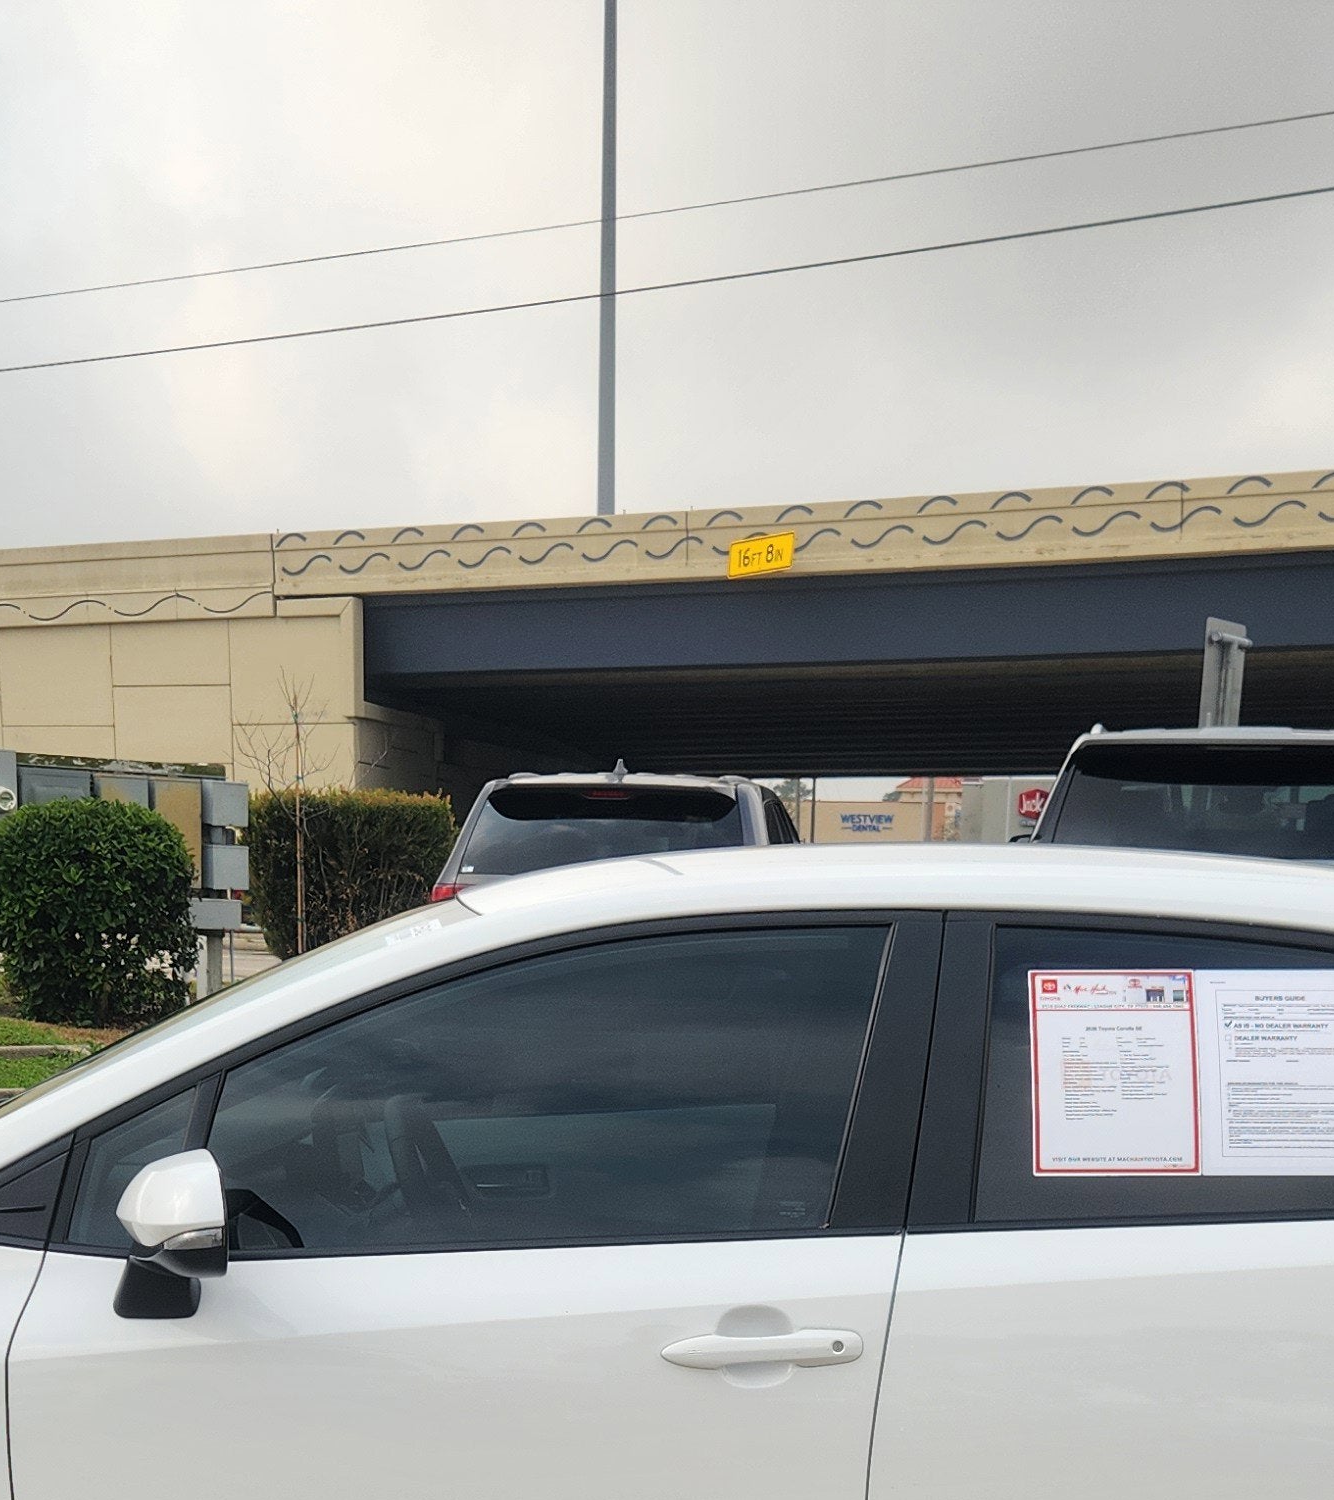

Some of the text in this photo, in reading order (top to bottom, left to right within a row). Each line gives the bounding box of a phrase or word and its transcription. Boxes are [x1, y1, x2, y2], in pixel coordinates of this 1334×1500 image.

[1019, 791, 1045, 814] Jack
[840, 814, 894, 824] WESTVIEW
[852, 824, 880, 832] DENTAL
